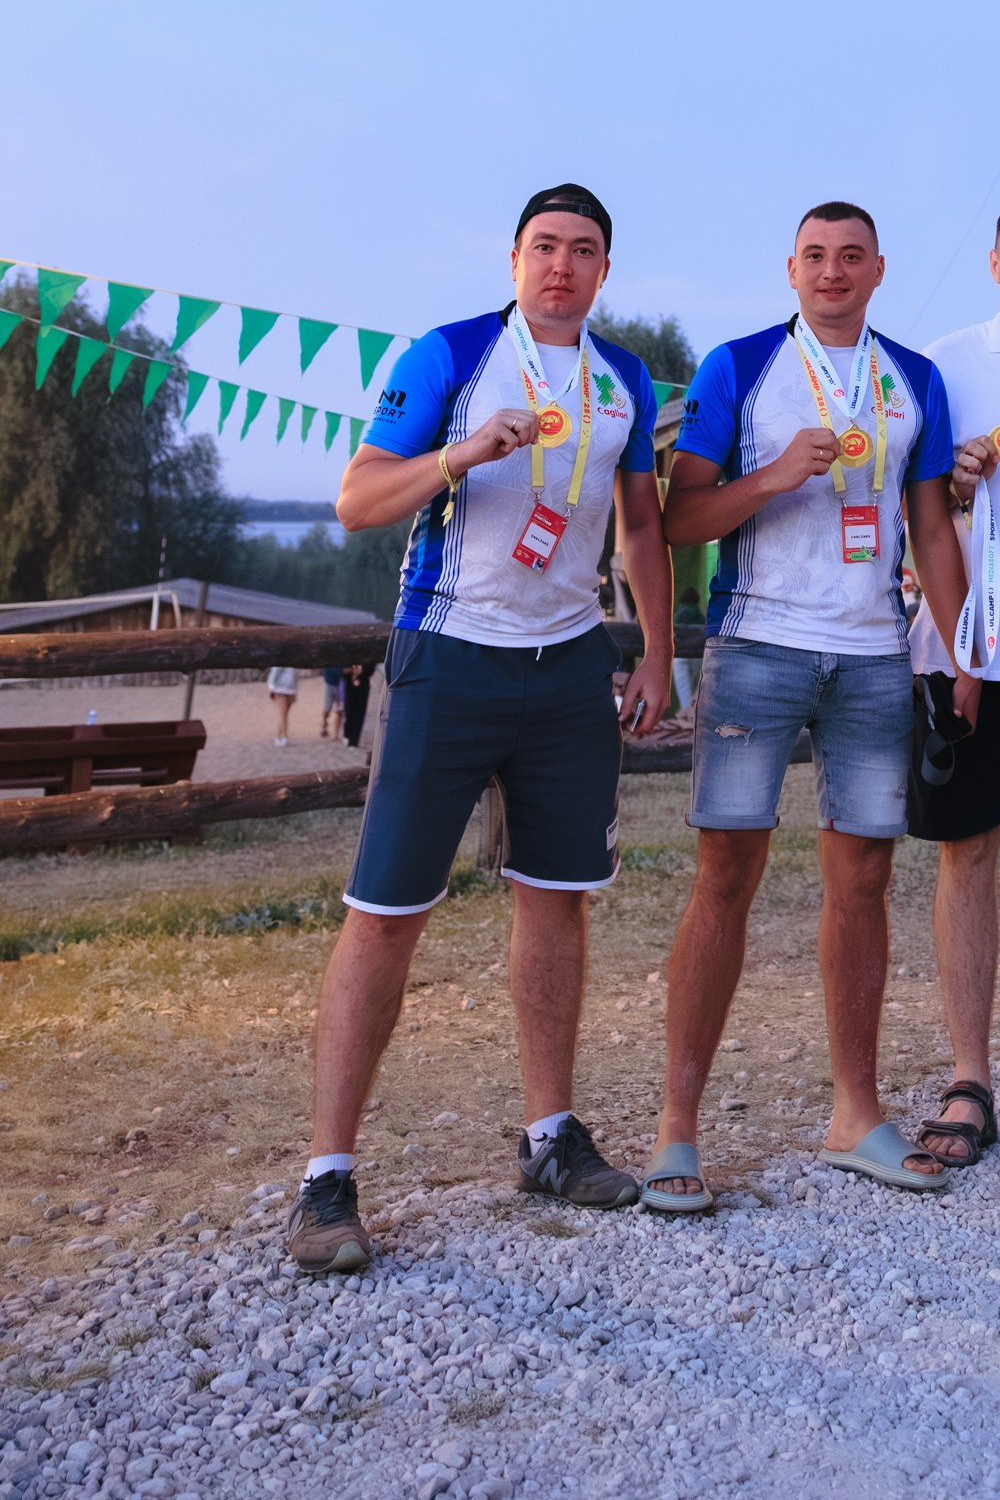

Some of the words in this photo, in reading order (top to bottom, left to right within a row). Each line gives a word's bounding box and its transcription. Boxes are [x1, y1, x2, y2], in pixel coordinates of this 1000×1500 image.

[597, 407, 628, 420] Cagliari
[871, 407, 905, 421] Cgliari
[959, 607, 970, 651] SPORTFEST
